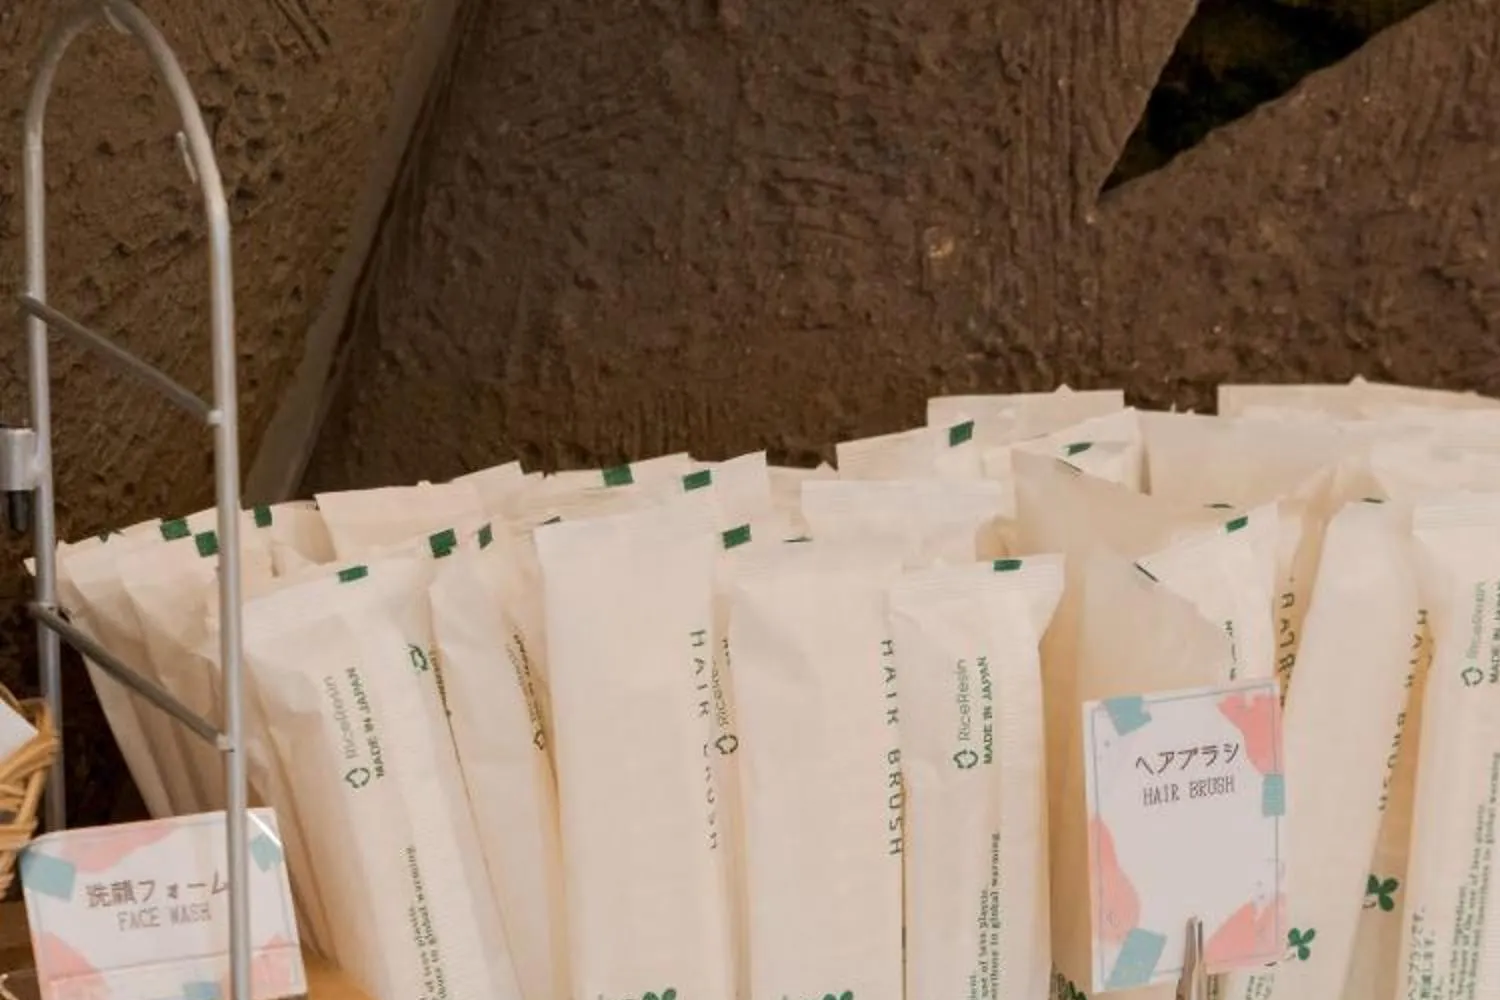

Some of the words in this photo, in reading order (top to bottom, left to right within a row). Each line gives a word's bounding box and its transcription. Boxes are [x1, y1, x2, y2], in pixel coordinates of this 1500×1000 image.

[979, 656, 993, 700] JAPAN
[983, 705, 993, 721] IN
[983, 724, 993, 765] MADE
[1136, 743, 1239, 775] ヘアブラシ
[888, 749, 904, 857] BRUSH
[1143, 783, 1181, 806] HAIR
[1189, 775, 1235, 799] BRUSH
[116, 906, 160, 931] FACE
[168, 902, 212, 925] WASH
